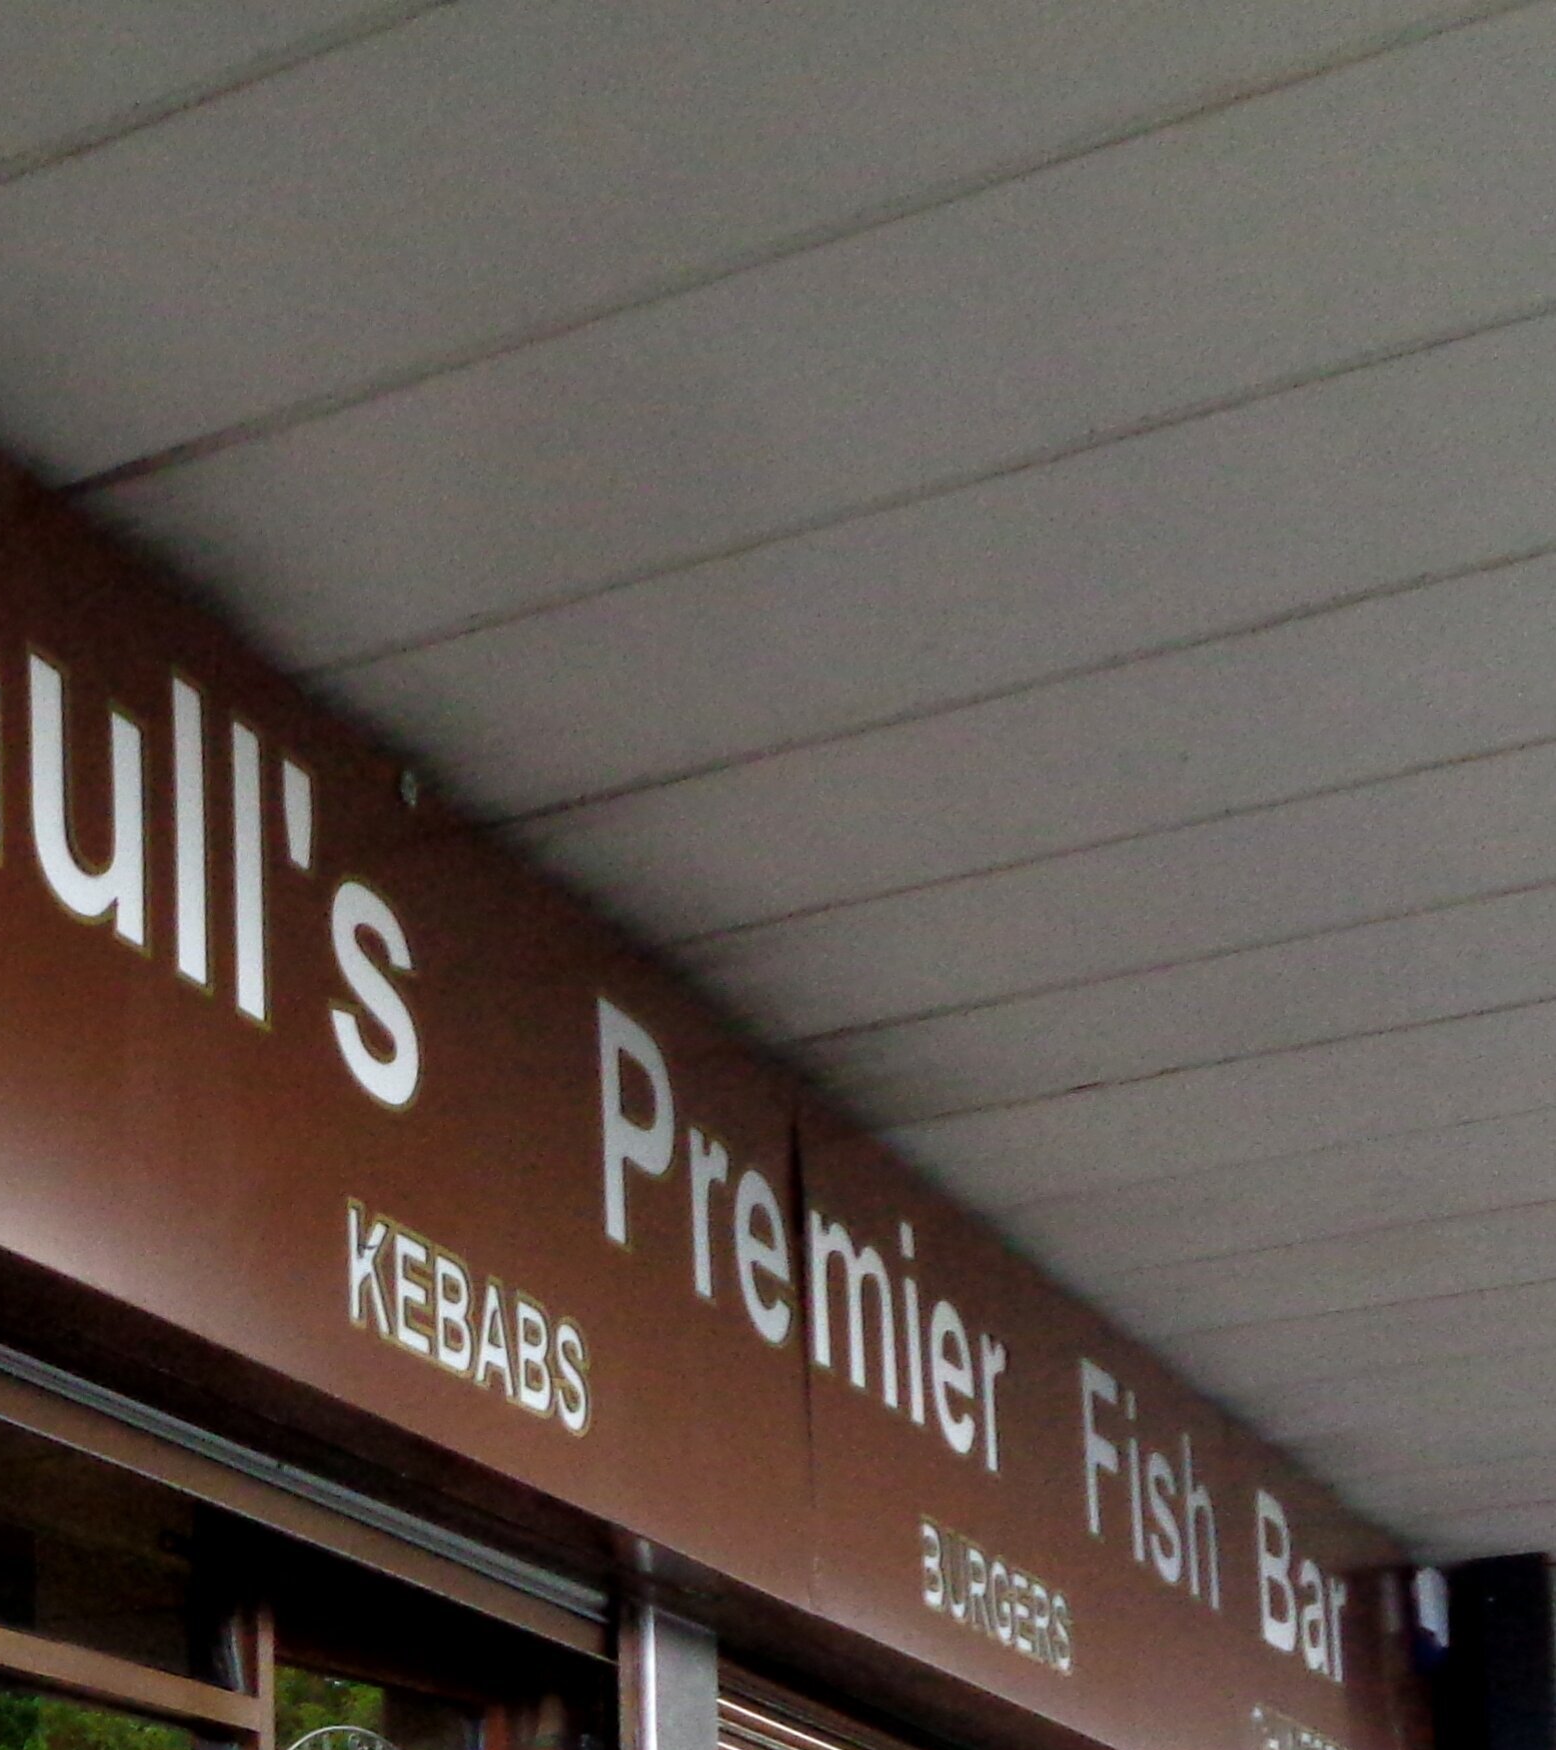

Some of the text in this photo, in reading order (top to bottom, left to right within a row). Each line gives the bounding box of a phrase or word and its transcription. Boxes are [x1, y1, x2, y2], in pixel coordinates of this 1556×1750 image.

[347, 1197, 590, 1437] KEBABS
[598, 996, 1007, 1476] Premier
[1080, 1356, 1220, 1612] Fish
[1255, 1488, 1347, 1683] Bar
[920, 1513, 1073, 1677] BURGERS
